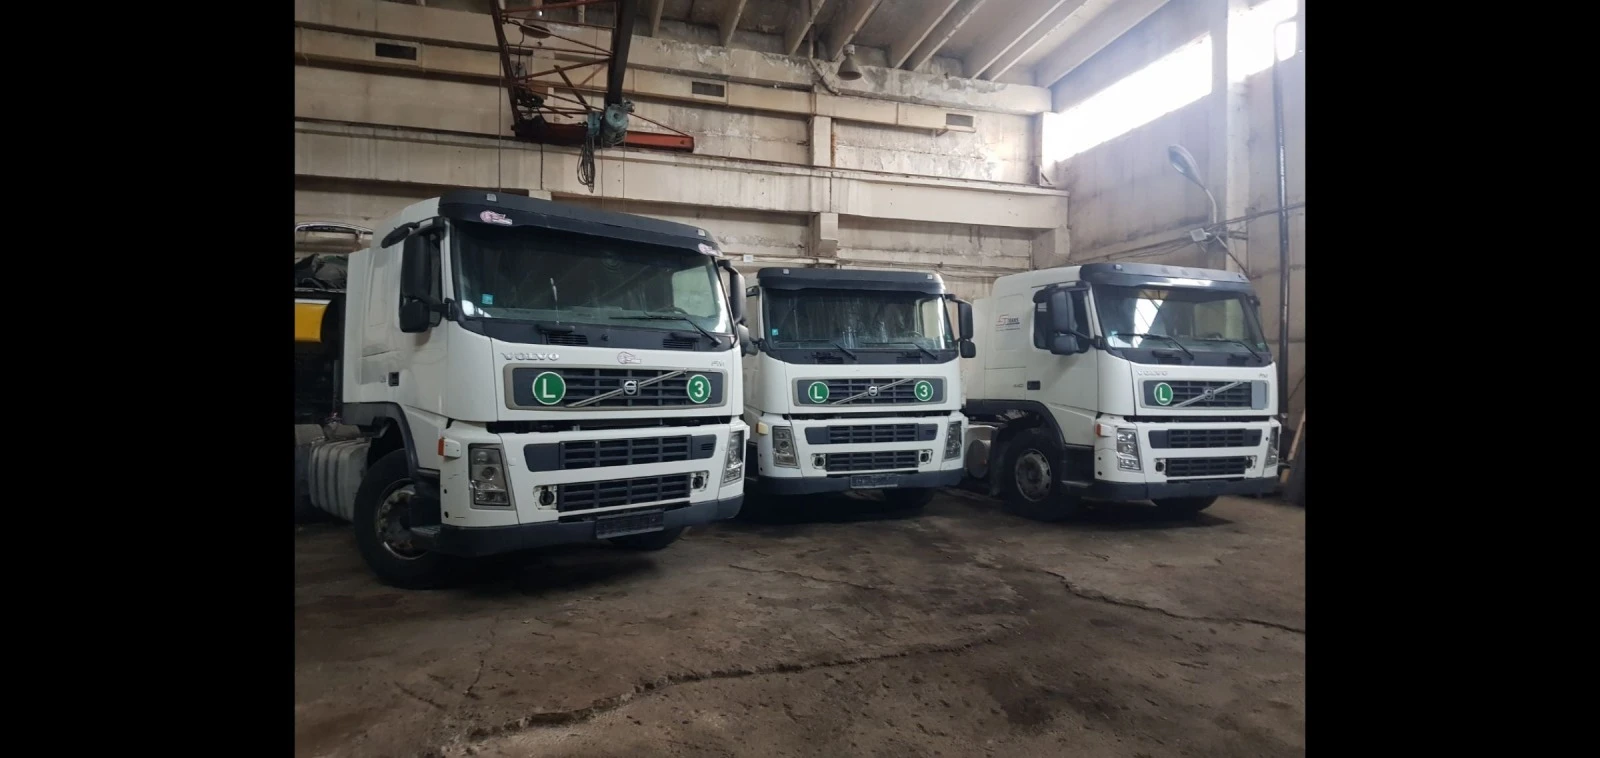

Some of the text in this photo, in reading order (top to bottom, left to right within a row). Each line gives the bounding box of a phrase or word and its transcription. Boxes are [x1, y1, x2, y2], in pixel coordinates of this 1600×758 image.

[501, 352, 560, 361] VOLVO
[543, 378, 556, 399] L
[694, 381, 704, 398] 3
[814, 386, 823, 399] L
[920, 385, 928, 398] 3
[1160, 387, 1168, 401] L
